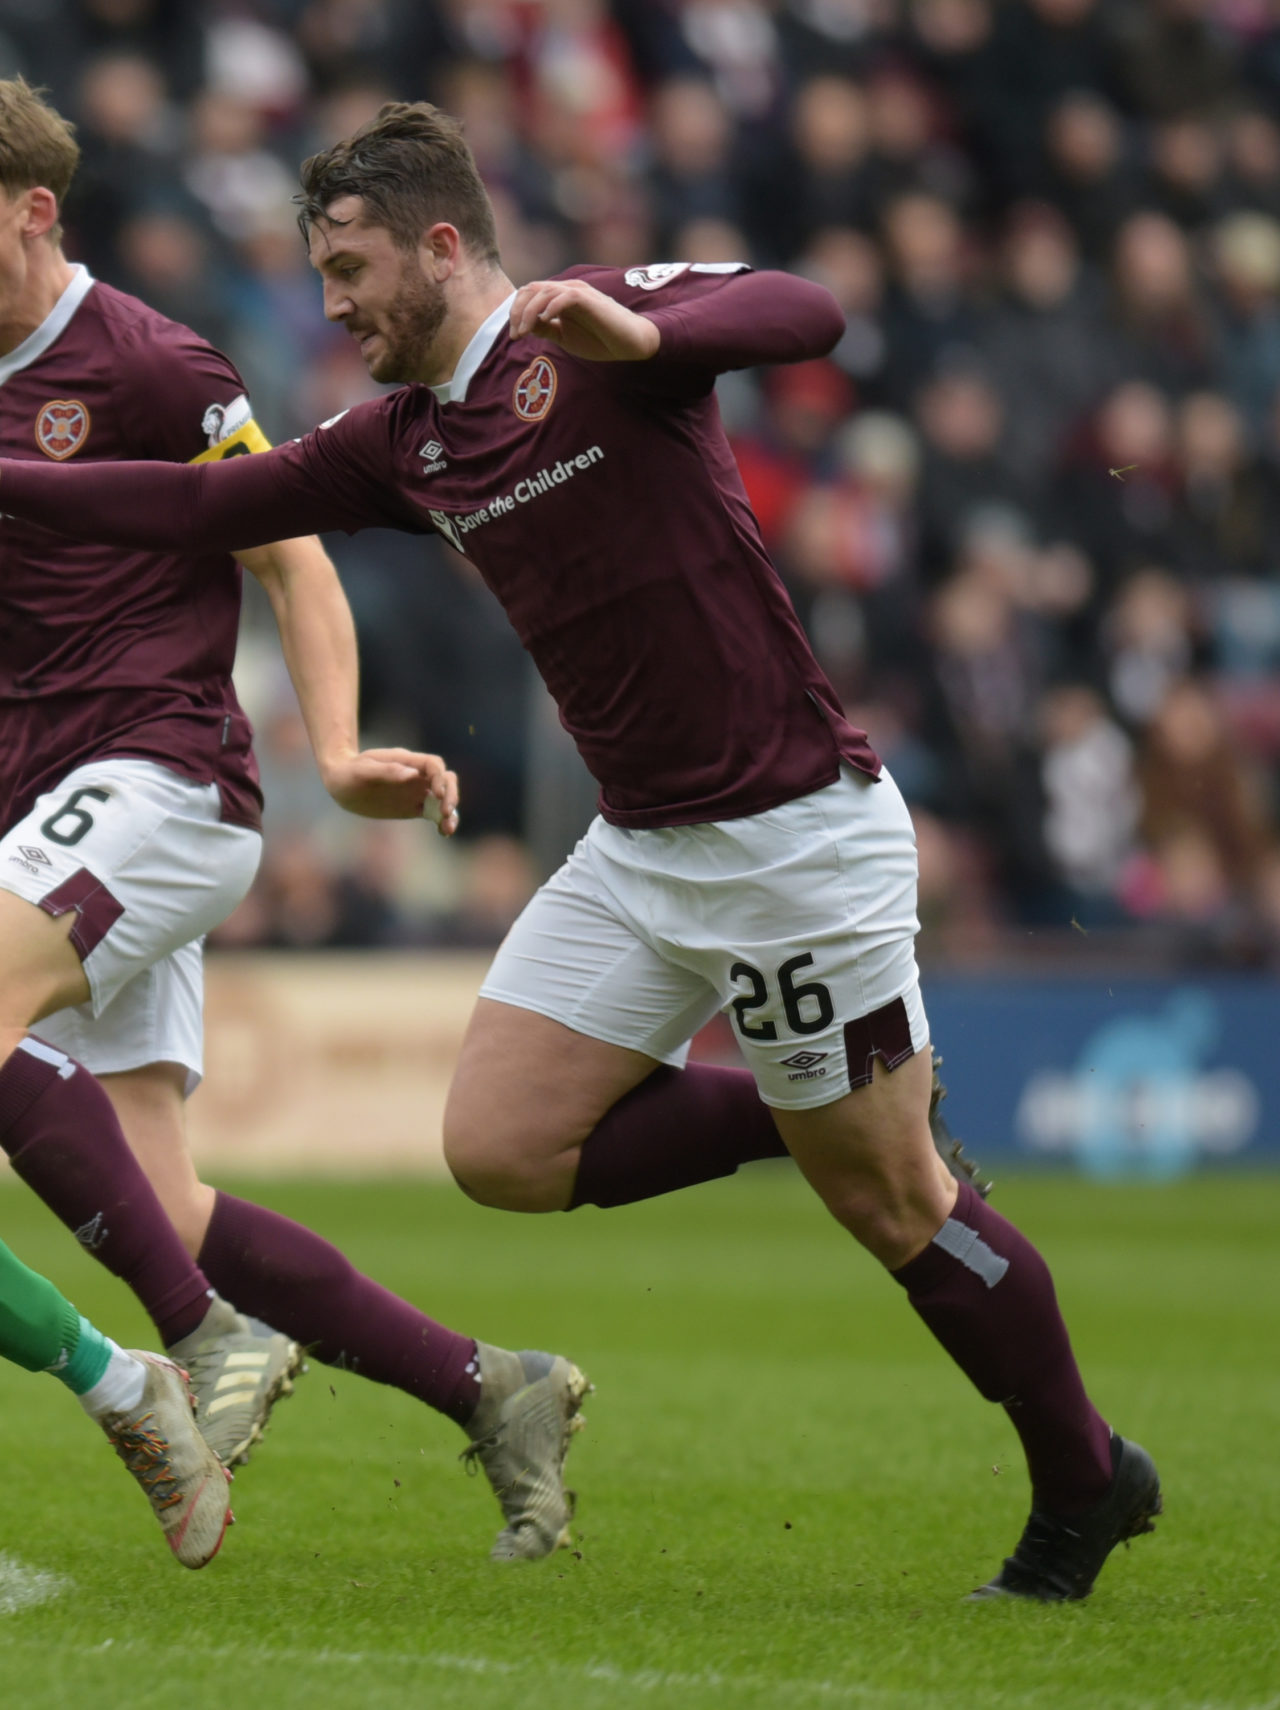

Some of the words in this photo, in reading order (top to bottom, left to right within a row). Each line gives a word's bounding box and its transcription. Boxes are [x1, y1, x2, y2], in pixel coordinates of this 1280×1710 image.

[423, 459, 448, 474] umbro
[455, 508, 491, 533] Save
[488, 496, 516, 518] the
[514, 445, 605, 503] Children
[40, 787, 111, 847] 6
[730, 952, 835, 1041] 26
[788, 1067, 826, 1081] umbro
